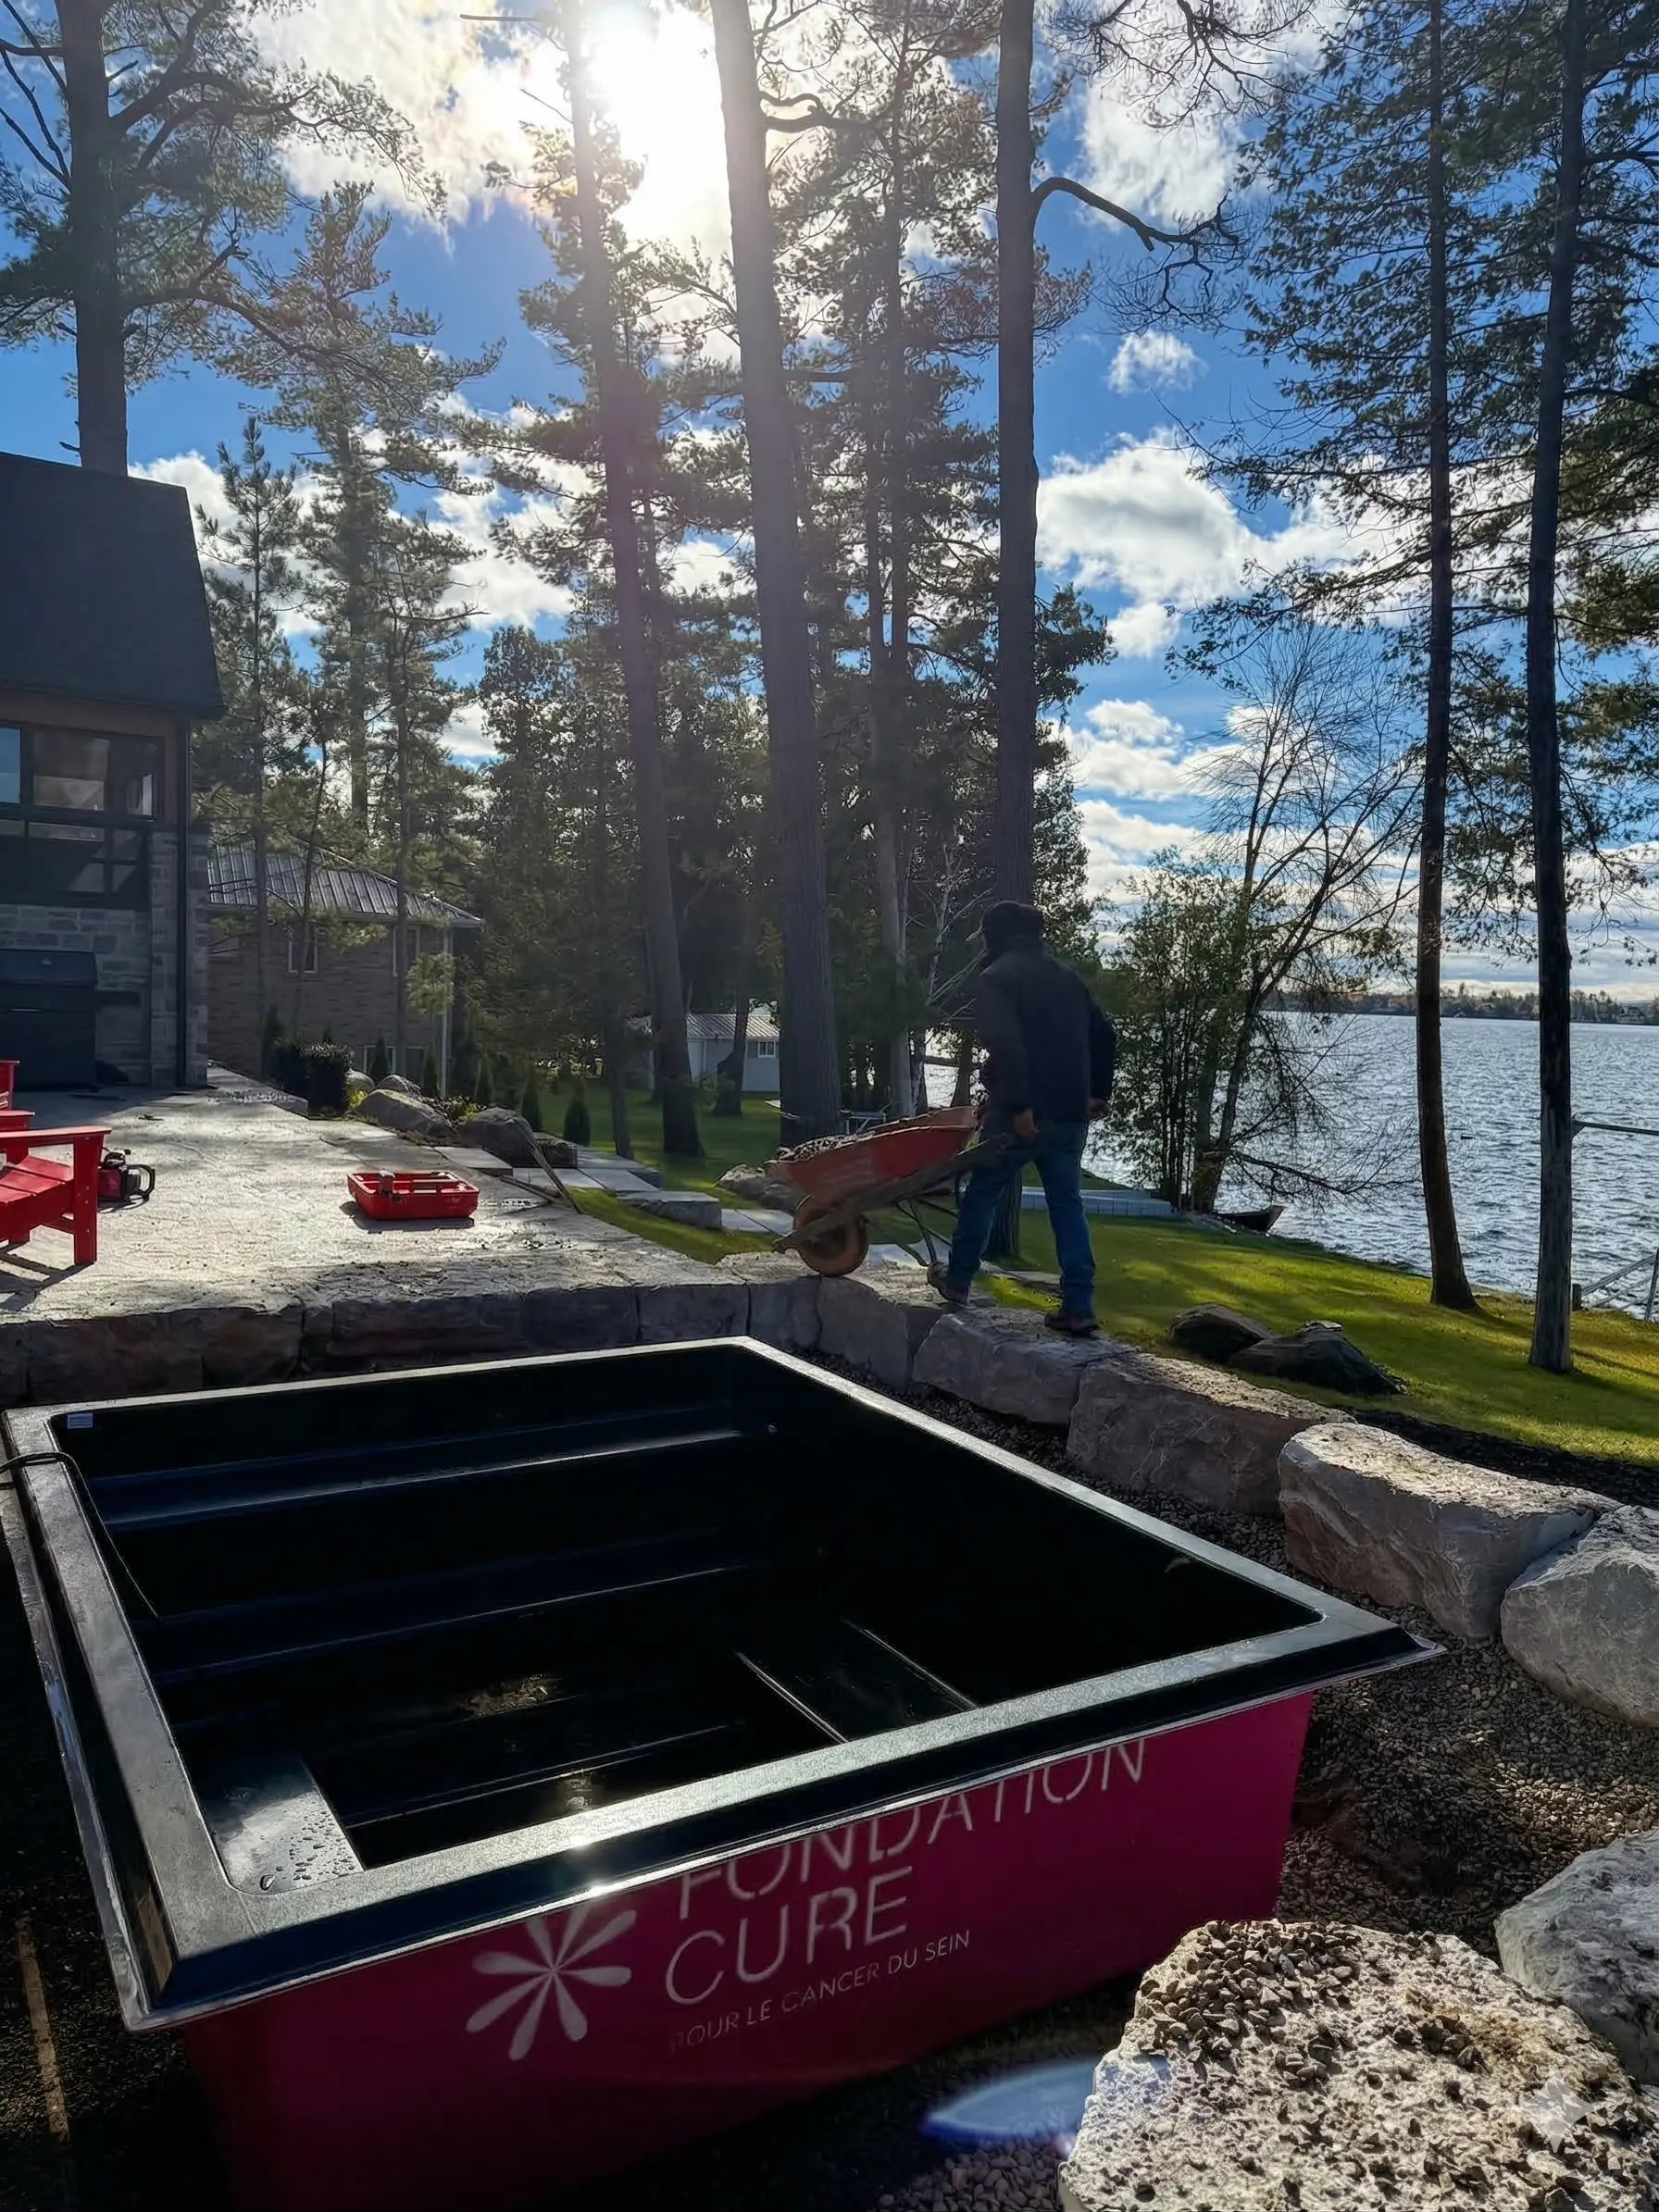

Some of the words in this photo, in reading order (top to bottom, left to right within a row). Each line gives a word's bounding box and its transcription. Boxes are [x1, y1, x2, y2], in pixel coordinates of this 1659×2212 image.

[666, 1866, 913, 2005] CURE
[746, 1999, 773, 2026] LE
[781, 1962, 879, 2013] CANCER
[888, 1947, 918, 1975] DU
[925, 1929, 970, 1962] SEIN
